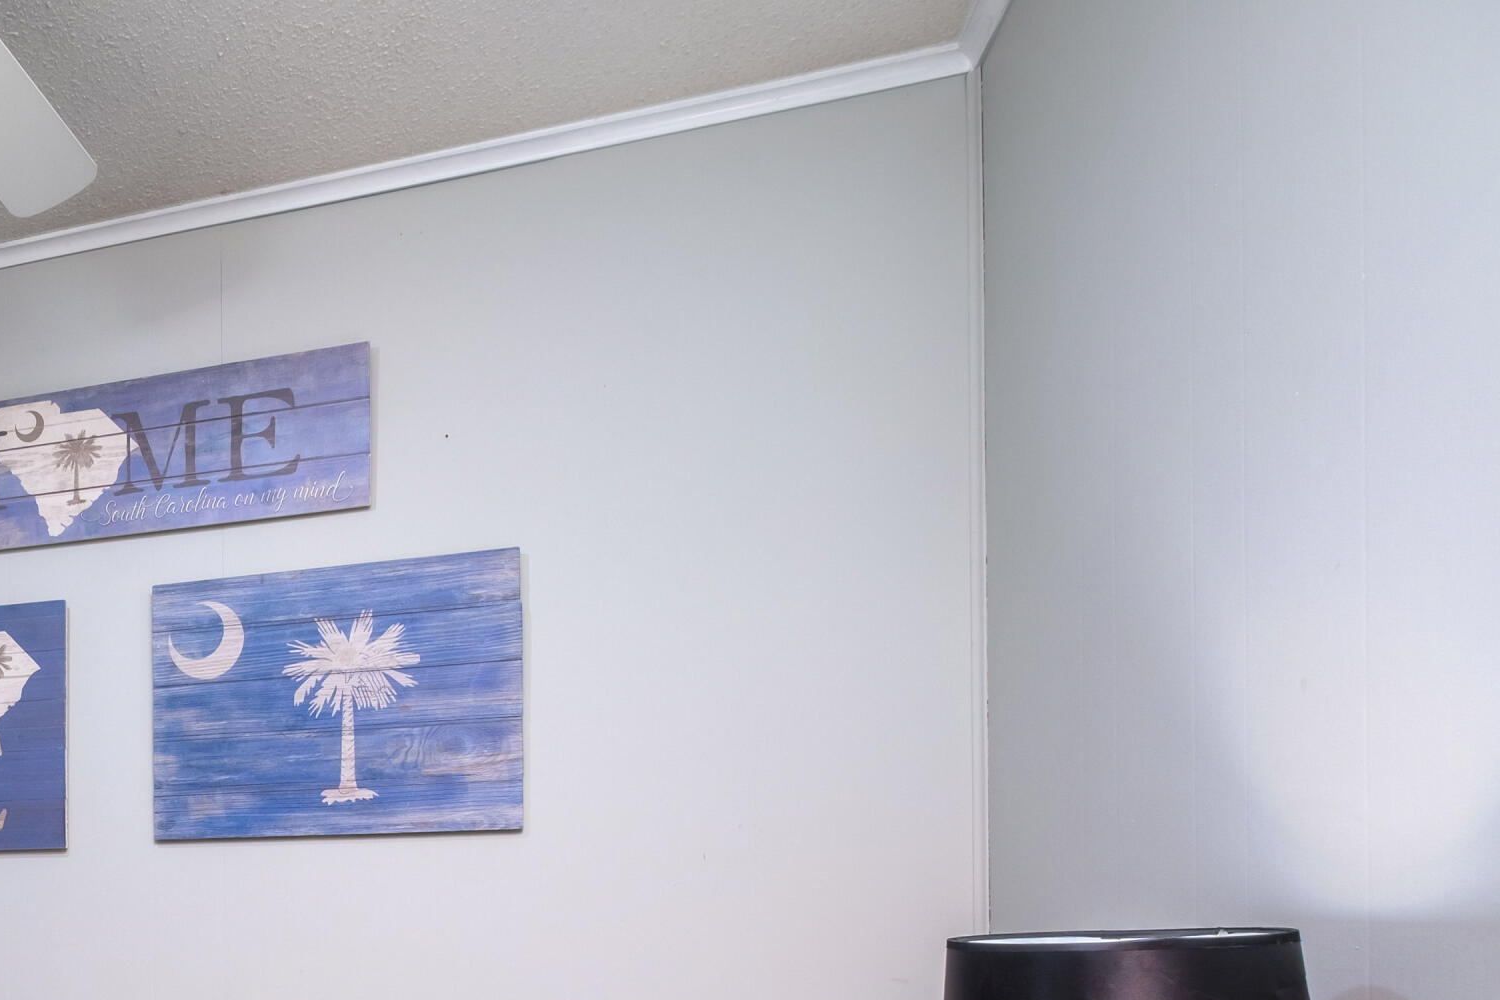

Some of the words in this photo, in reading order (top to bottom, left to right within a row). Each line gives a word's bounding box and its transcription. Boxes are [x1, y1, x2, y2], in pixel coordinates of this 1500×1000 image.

[81, 496, 153, 526] South
[154, 487, 230, 518] Carolina
[234, 492, 255, 508] on
[261, 486, 288, 513] my
[293, 471, 355, 502] mind
